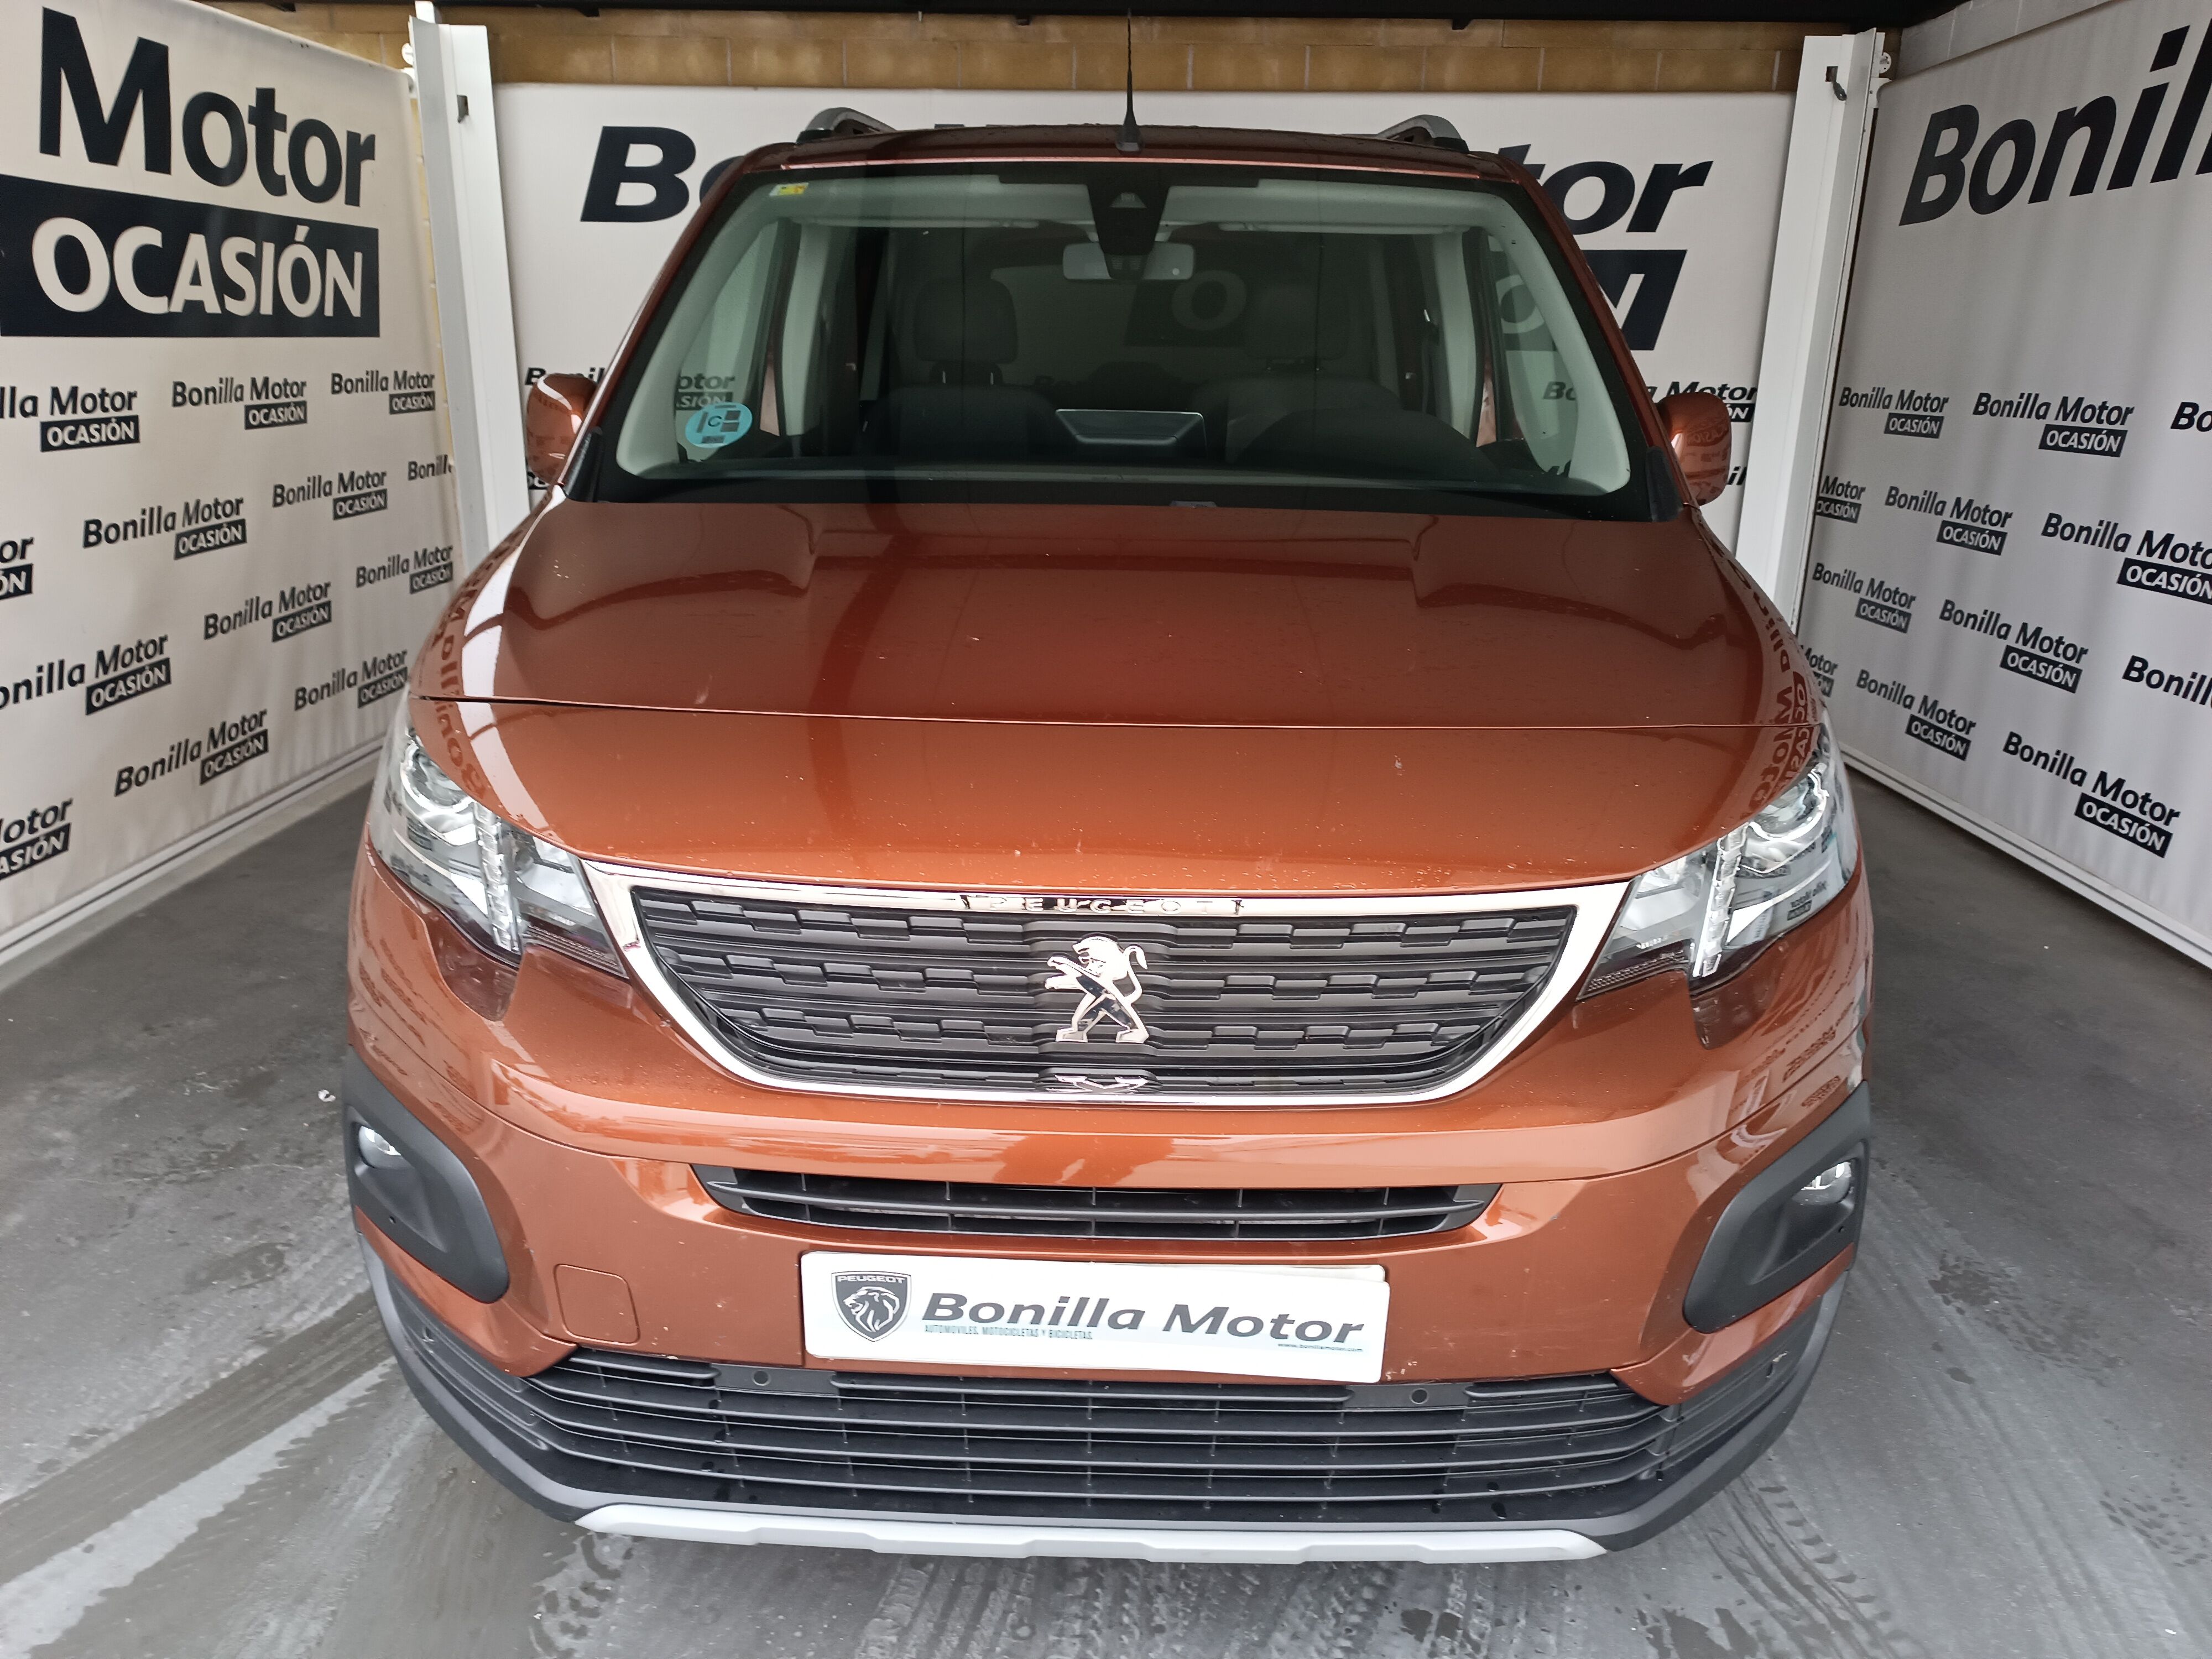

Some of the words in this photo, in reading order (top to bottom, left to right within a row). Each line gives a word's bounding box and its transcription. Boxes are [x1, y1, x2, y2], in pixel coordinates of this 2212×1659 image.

[40, 7, 376, 207] Motor
[1899, 18, 2212, 226] Bonil
[32, 217, 362, 320] OCASIÓN
[50, 385, 137, 416] Motor
[171, 377, 244, 408] Bonilla
[250, 376, 307, 401] Motor
[331, 369, 389, 395] Bonilla
[393, 370, 435, 390] Motor
[392, 392, 433, 411] OCASIÓN
[677, 373, 736, 389] otor
[1839, 387, 1893, 410] Bonilla
[1895, 389, 1950, 413] Motor
[248, 403, 305, 426] OCASIÓN
[1888, 416, 1940, 435] OCASIÓN
[1973, 392, 2052, 420] Bonilla
[2054, 395, 2135, 426] Motor
[46, 418, 136, 447] OCASIÓN
[2046, 430, 2122, 452] OCASIÓN
[272, 474, 332, 508] Bonilla
[337, 470, 388, 494] Motor
[336, 491, 385, 516] OCASIÓN
[1820, 474, 1866, 501] Motor
[1884, 486, 1947, 517] Bonilla
[1949, 497, 2013, 528] Motor
[82, 505, 176, 549] Bonilla
[182, 497, 244, 528] Motor
[178, 522, 242, 554] OCASIÓN
[1942, 530, 2002, 551] OCASIÓN
[2041, 512, 2132, 553] Bonilla
[2136, 530, 2212, 570] Moto
[356, 554, 410, 589] Bonilla
[413, 545, 453, 570] Motor
[1812, 562, 1864, 594] Bonilla
[1865, 578, 1917, 609] Motor
[203, 596, 273, 640] Bonilla
[278, 581, 332, 614] Motor
[276, 606, 330, 637] OCASIÓN
[1859, 603, 1908, 629] OCASIÓN
[1939, 599, 2012, 640] Bonilla
[2015, 622, 2089, 664] Motor
[94, 634, 169, 679] Motor
[2006, 651, 2077, 688] OCASIÓN
[91, 665, 166, 708] OCASIÓN
[294, 667, 358, 712] Bonilla
[361, 649, 408, 682] Motor
[2122, 655, 2212, 709] Bonill
[1856, 669, 1916, 710] Bonilla
[1917, 694, 1977, 735] Motor
[113, 738, 202, 797] Bonilla
[206, 708, 268, 753] Motor
[204, 734, 264, 778] OCASIÓN
[1911, 721, 1966, 756] OCASIÓN
[2002, 731, 2088, 787] Bonilla
[2091, 770, 2181, 826] Motor
[0, 797, 74, 843] otor
[2082, 801, 2166, 851] OCASIÓN
[0, 831, 65, 874] ASIÓN
[837, 1275, 906, 1284] PEUGEOT
[921, 1292, 1147, 1331] Bonilla
[1162, 1303, 1365, 1344] Motor
